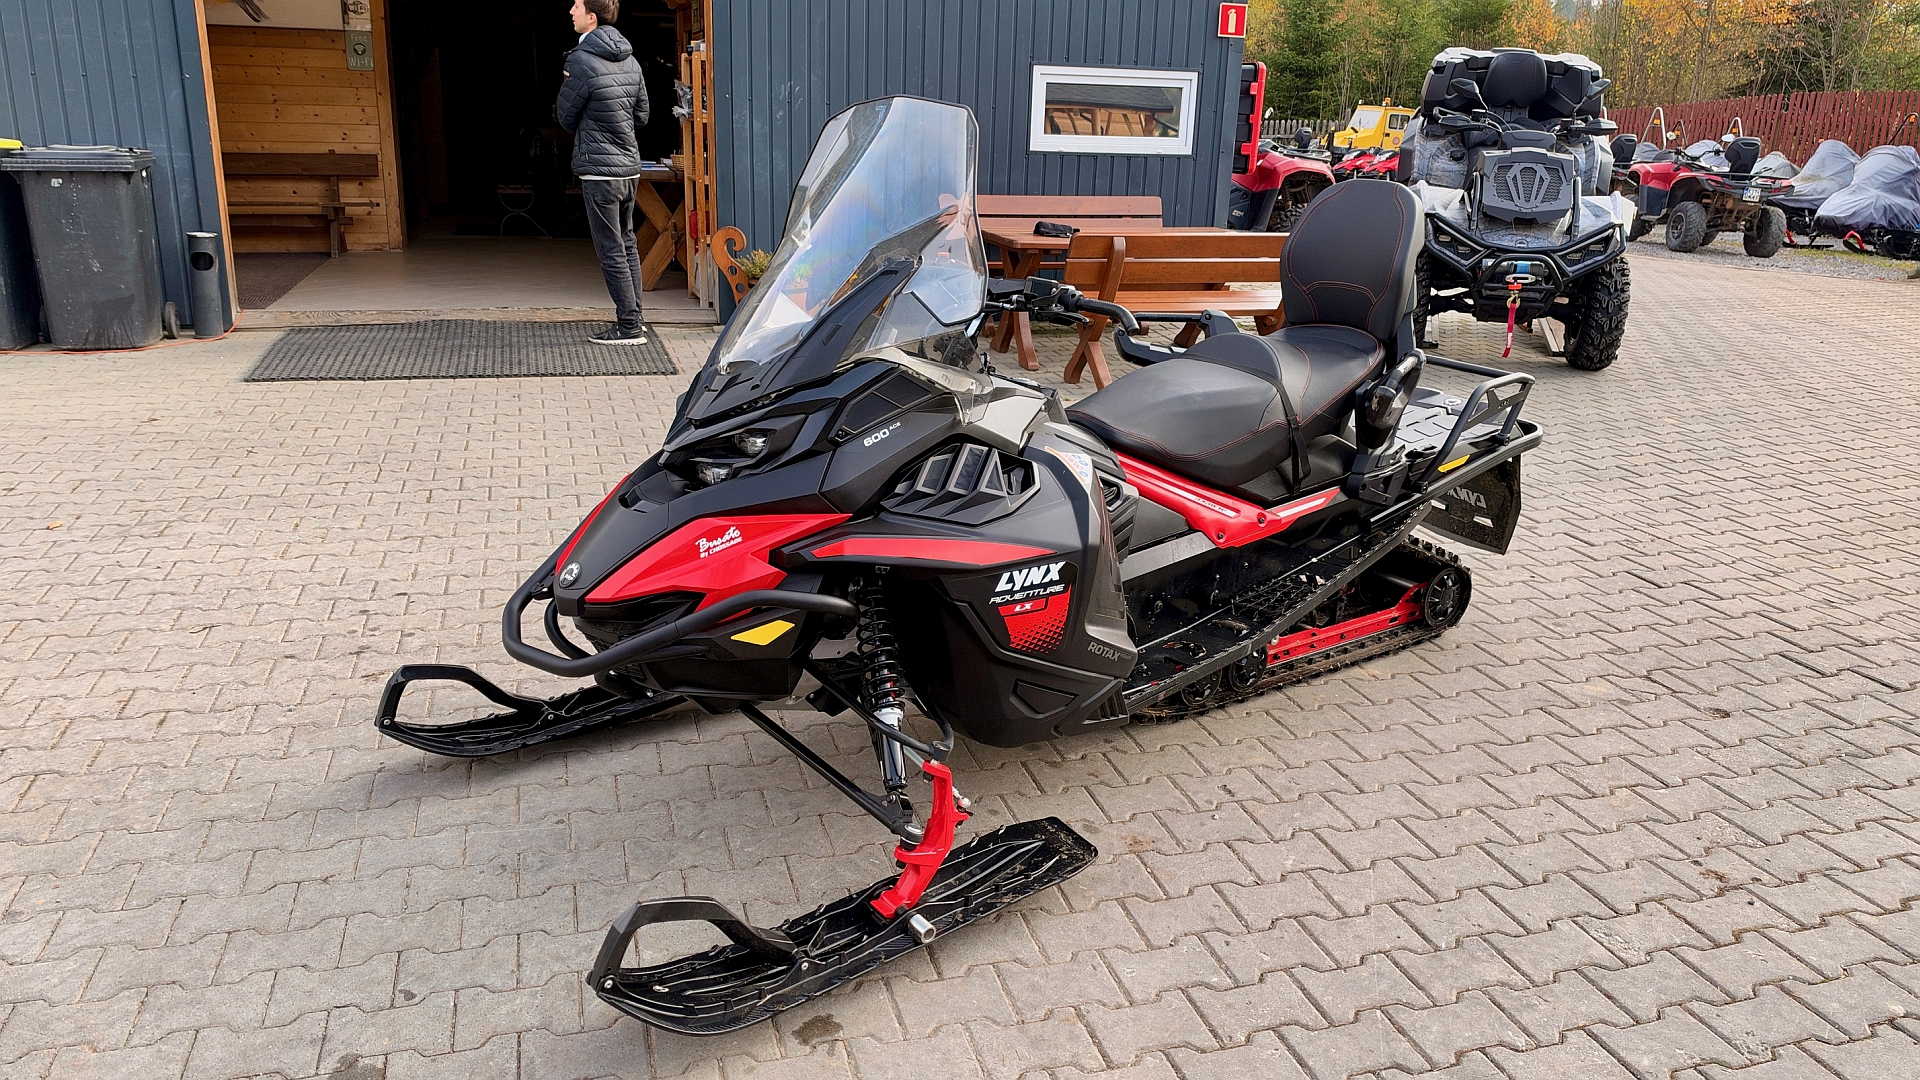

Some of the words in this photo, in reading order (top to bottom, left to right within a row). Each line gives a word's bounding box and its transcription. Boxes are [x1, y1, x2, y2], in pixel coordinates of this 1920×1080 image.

[351, 34, 367, 42] Free
[863, 429, 889, 447] 600
[889, 421, 902, 431] ACE
[695, 526, 740, 552] Busato
[995, 561, 1066, 592] LYNX
[988, 584, 1065, 604] ADVENTURE
[1014, 602, 1033, 611] LX
[1087, 641, 1121, 662] ROTAX
